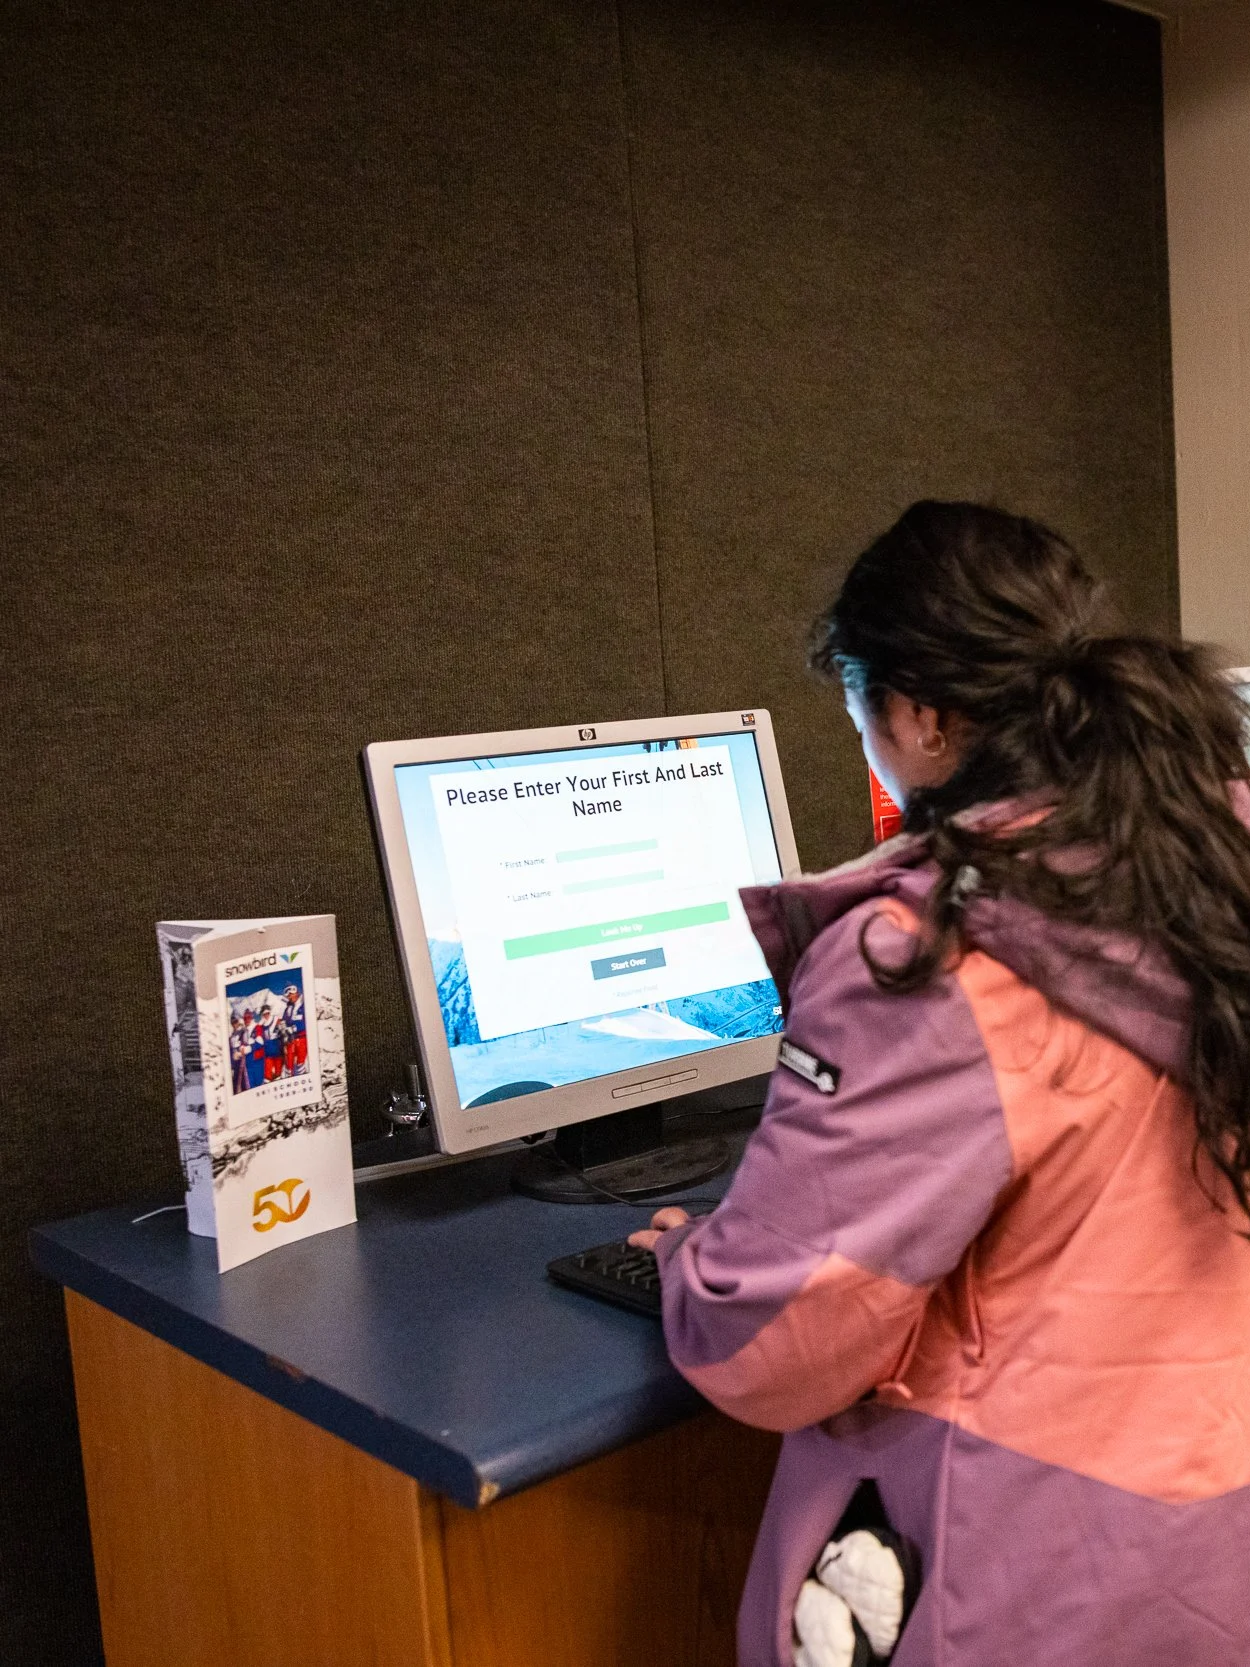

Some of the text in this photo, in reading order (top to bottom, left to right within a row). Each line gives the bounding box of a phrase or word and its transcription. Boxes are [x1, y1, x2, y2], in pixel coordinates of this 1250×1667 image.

[446, 760, 724, 806] Please Enter Your First And Last
[572, 799, 622, 817] Name
[225, 953, 277, 977] snowbird
[610, 958, 647, 971] Start Over
